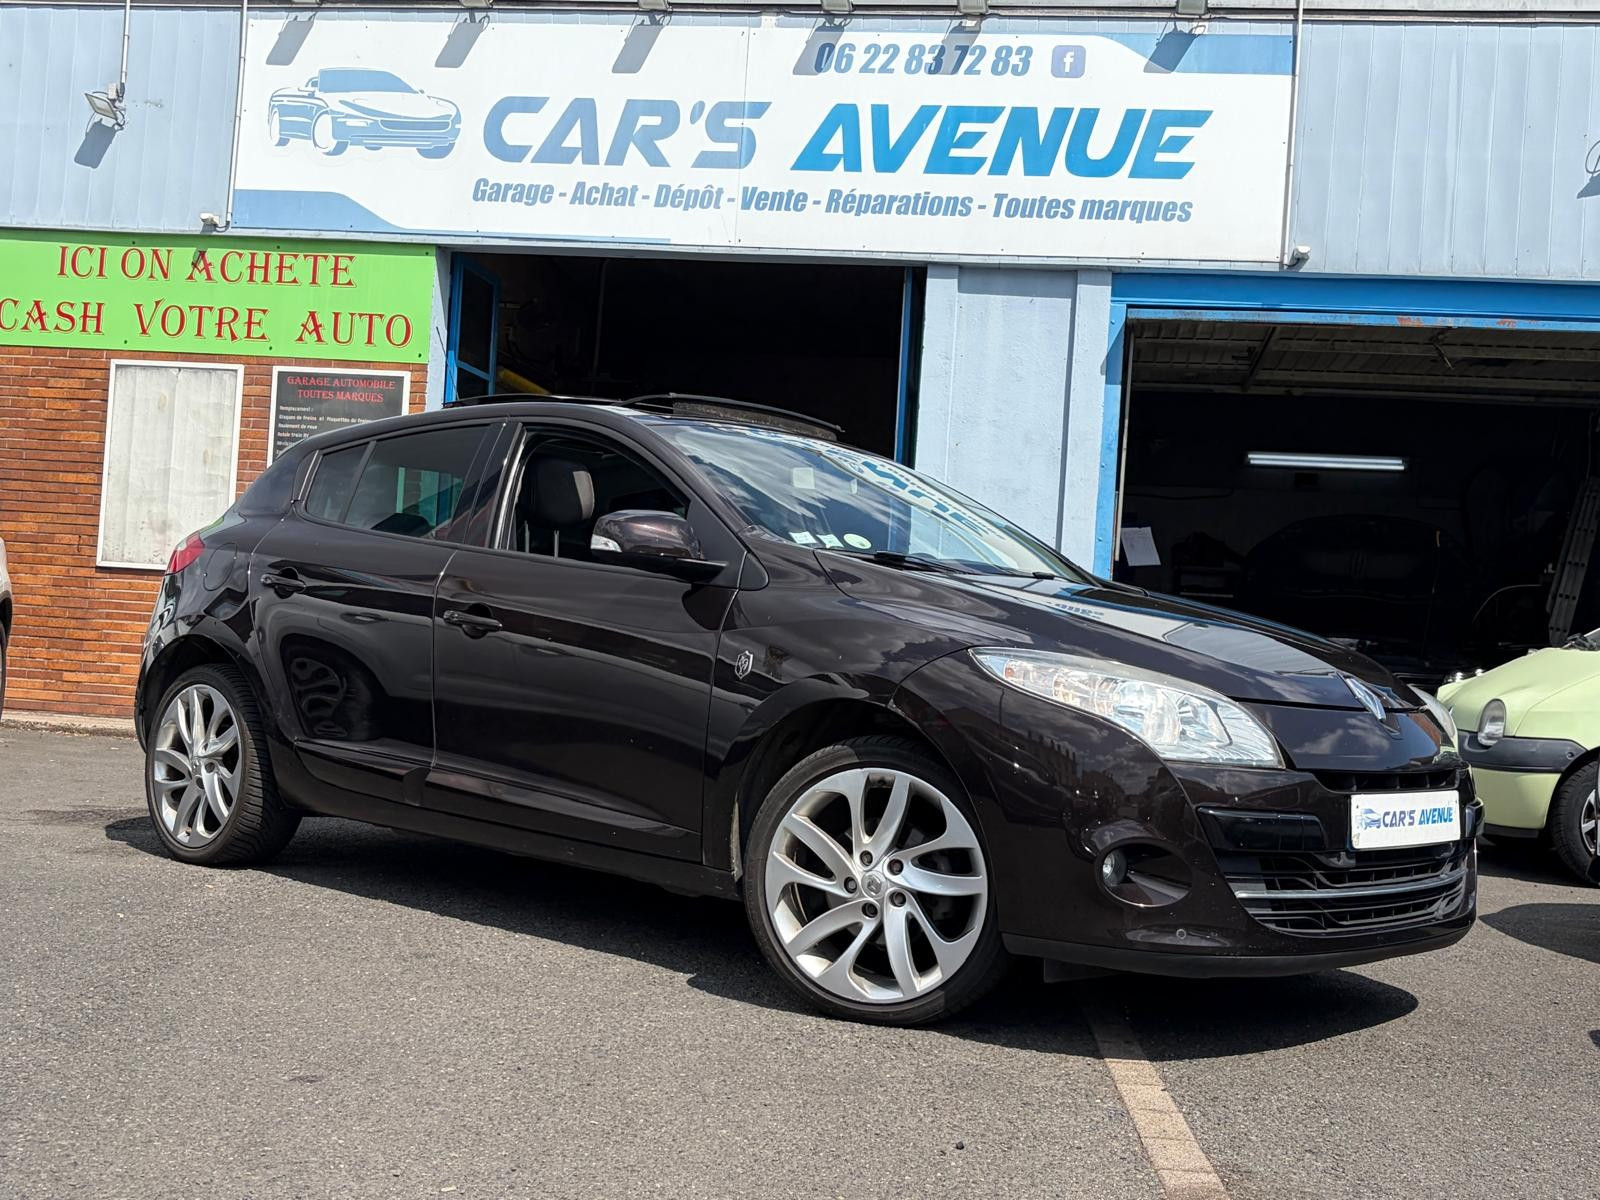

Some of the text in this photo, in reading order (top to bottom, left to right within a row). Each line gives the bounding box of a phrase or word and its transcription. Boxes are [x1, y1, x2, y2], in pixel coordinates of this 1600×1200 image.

[814, 42, 1033, 77] 06 22 83 72 83
[483, 96, 1214, 181] CAR'S AVENUE
[472, 178, 554, 207] Garage
[569, 181, 640, 208] Achat
[653, 184, 725, 211] Dépôt
[740, 186, 809, 213] Vente
[824, 188, 974, 217] Réparations
[992, 192, 1076, 220] Toutes
[1078, 199, 1194, 225] marques
[57, 245, 357, 288] ICI ON ACHETE
[0, 297, 413, 348] CASH VOTRE AUTO
[287, 376, 396, 390] GARAGE AUTOMOBILE
[298, 389, 384, 403] TOUTES MARQUES
[1382, 806, 1454, 828] CAR'S AVENUE
